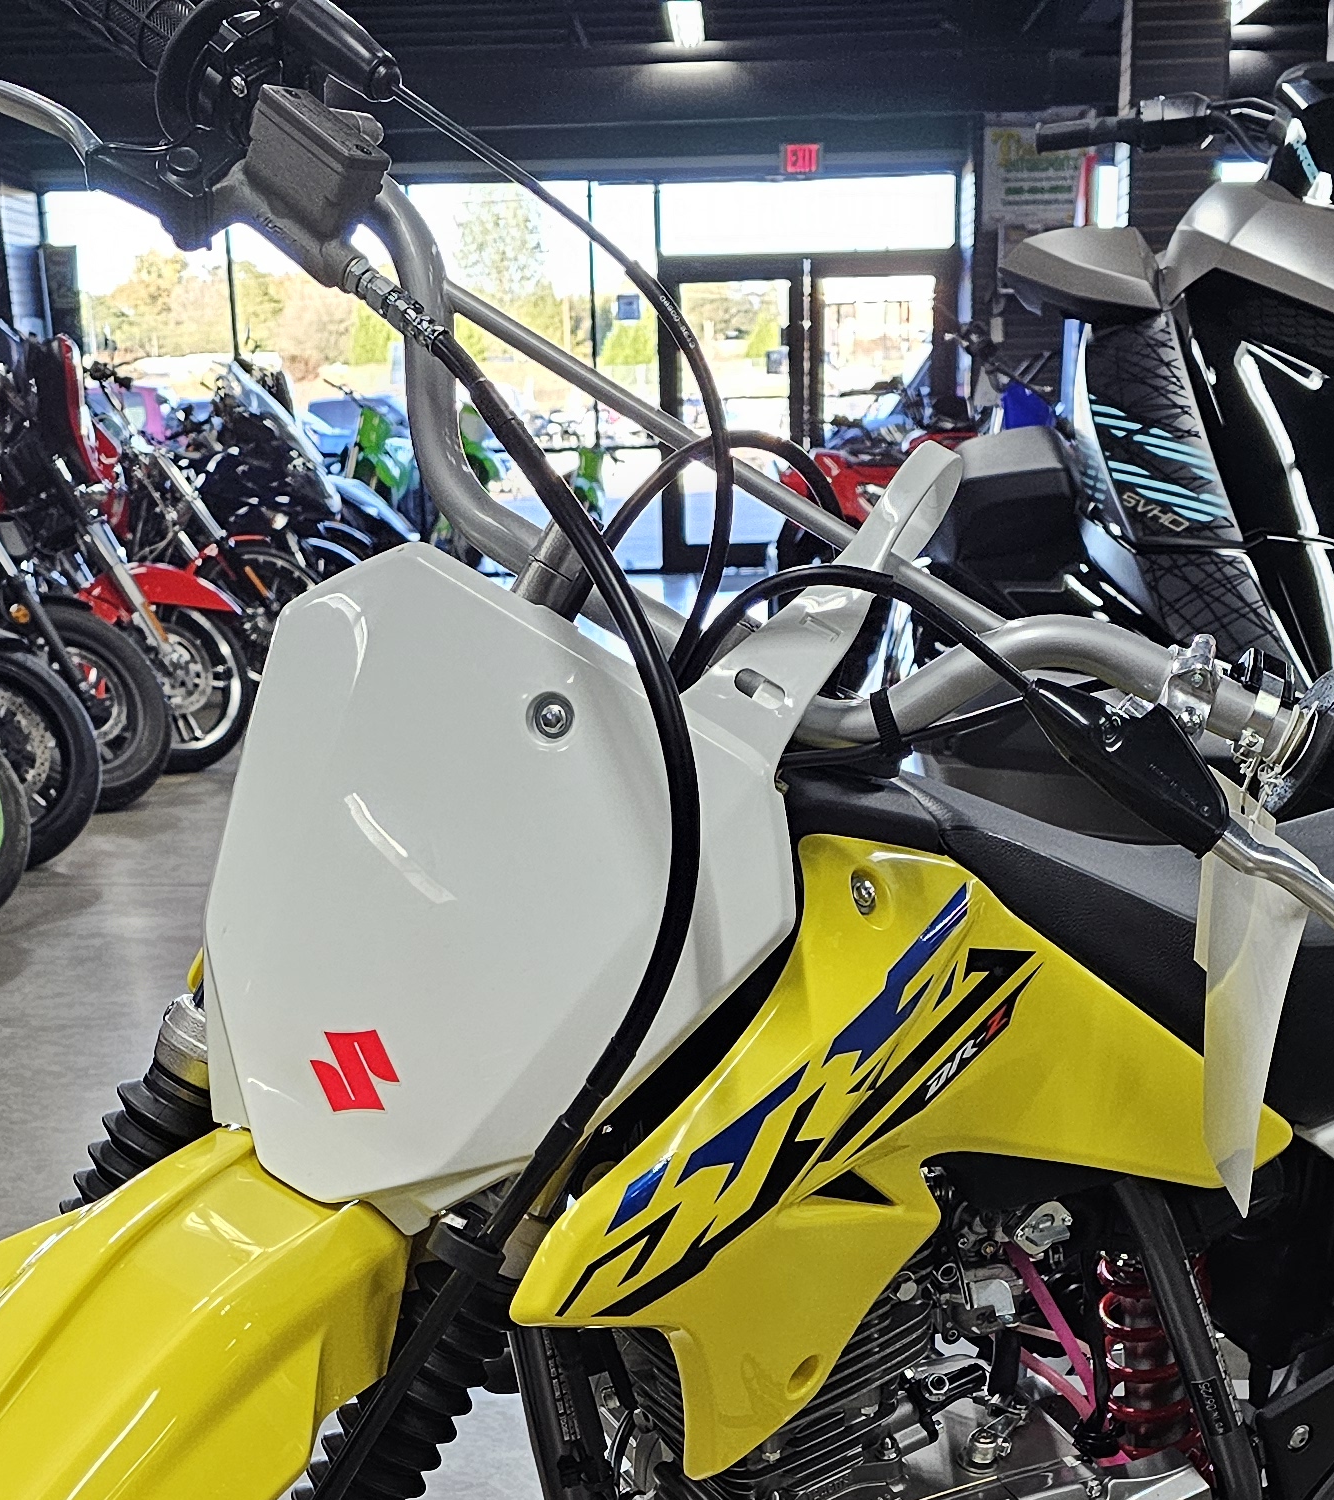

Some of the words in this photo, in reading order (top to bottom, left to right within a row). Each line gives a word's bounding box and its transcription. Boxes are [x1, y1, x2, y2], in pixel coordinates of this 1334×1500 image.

[788, 146, 817, 172] EXIT
[1122, 492, 1190, 532] SVHO
[924, 1003, 1009, 1101] DR-Z
